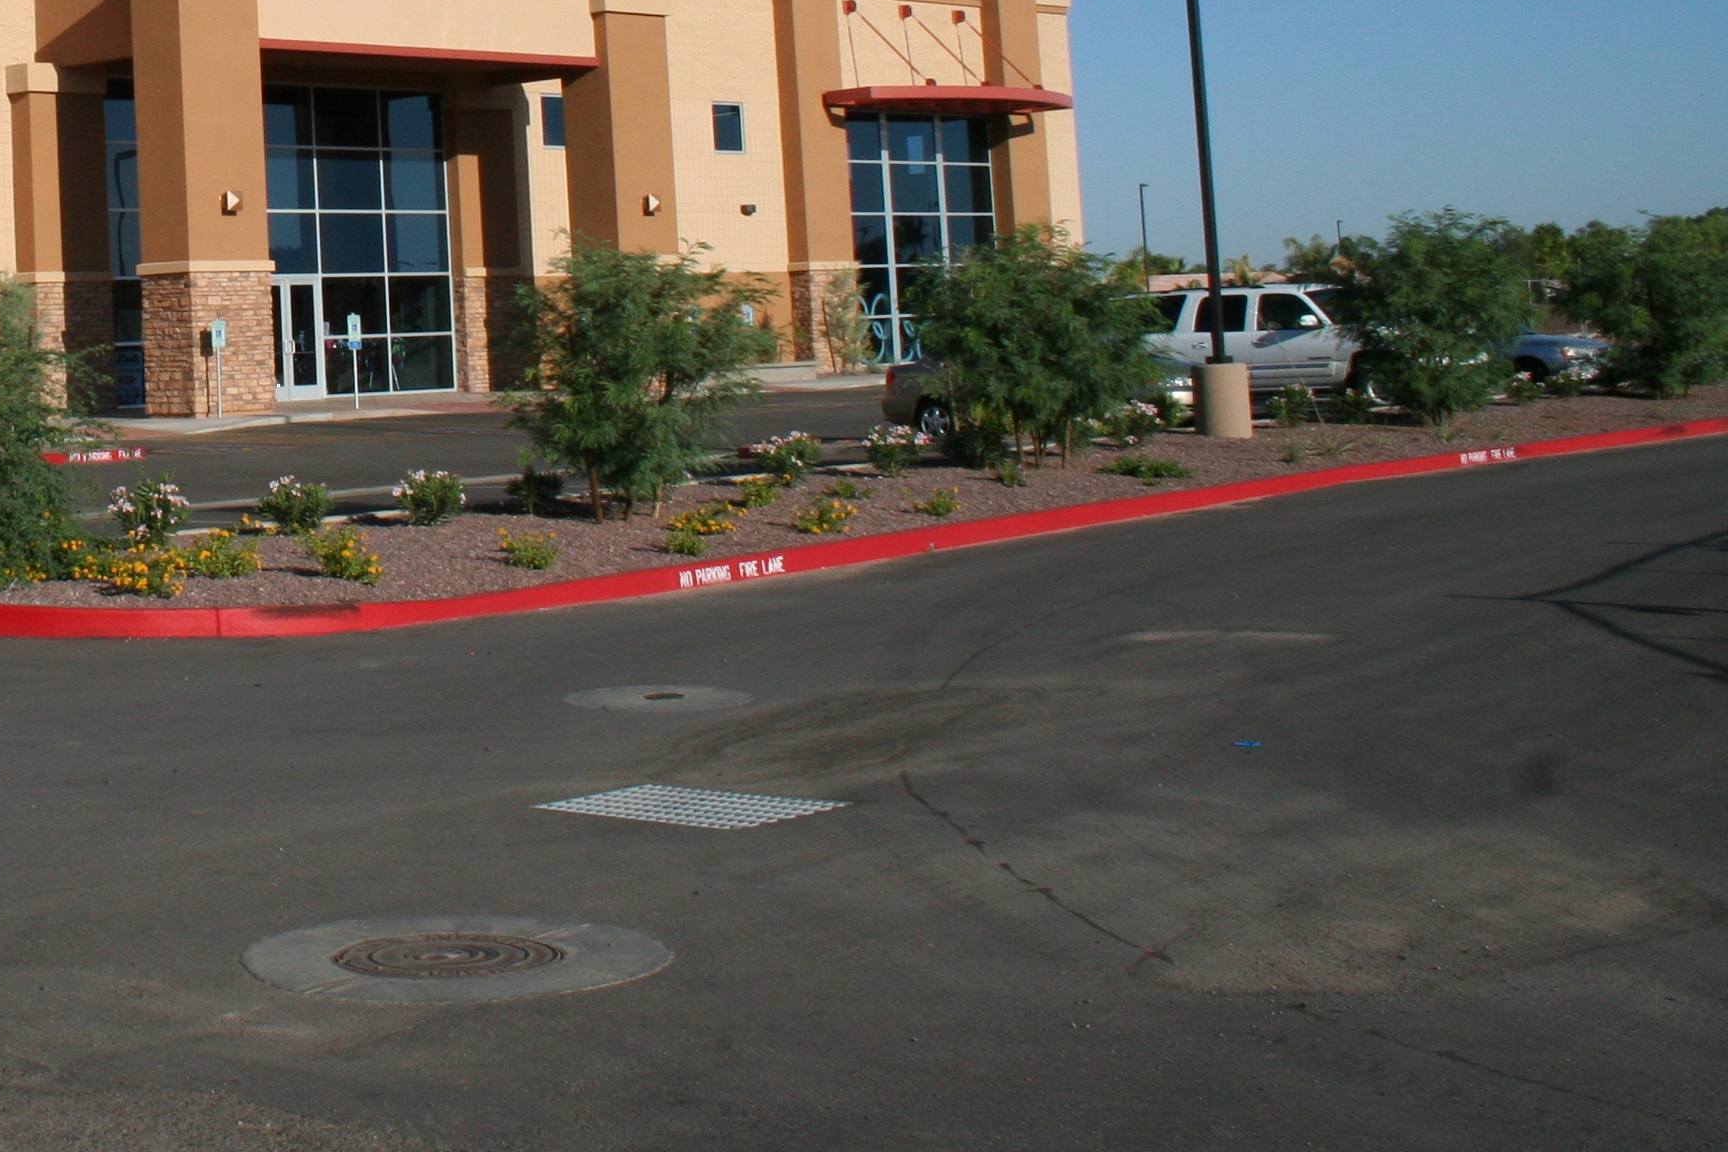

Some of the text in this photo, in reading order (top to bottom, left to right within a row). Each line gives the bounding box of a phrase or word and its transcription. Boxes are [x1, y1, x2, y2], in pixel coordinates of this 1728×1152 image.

[679, 555, 785, 588] NO PARKING FIRE LANE
